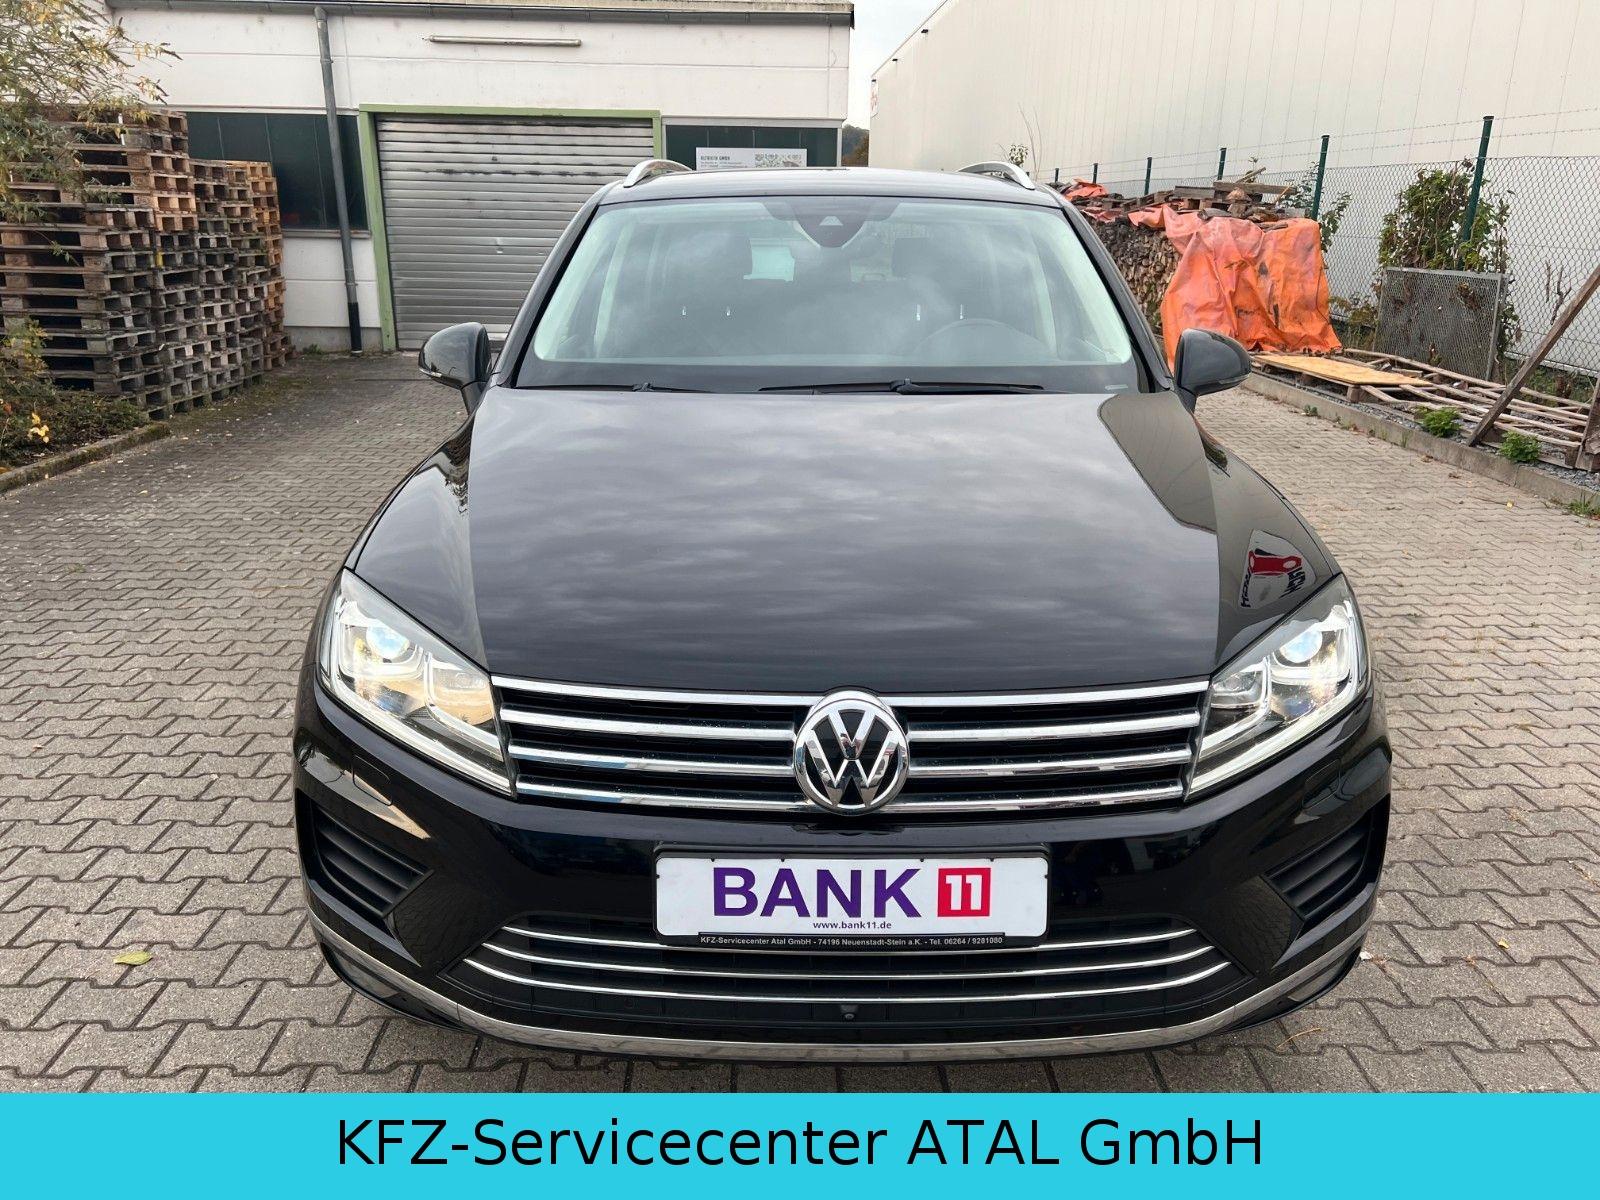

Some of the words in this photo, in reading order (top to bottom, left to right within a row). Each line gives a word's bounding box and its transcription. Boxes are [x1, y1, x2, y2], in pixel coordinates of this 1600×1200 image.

[799, 702, 904, 810] VW
[713, 867, 922, 918] BANK
[943, 872, 985, 913] 11
[813, 921, 892, 930] www.bank11.de
[700, 936, 770, 945] KFZ-Servicecenter
[771, 937, 786, 945] Atal
[841, 938, 906, 946] Neuenstadt-Stein
[929, 937, 941, 945] Tel.
